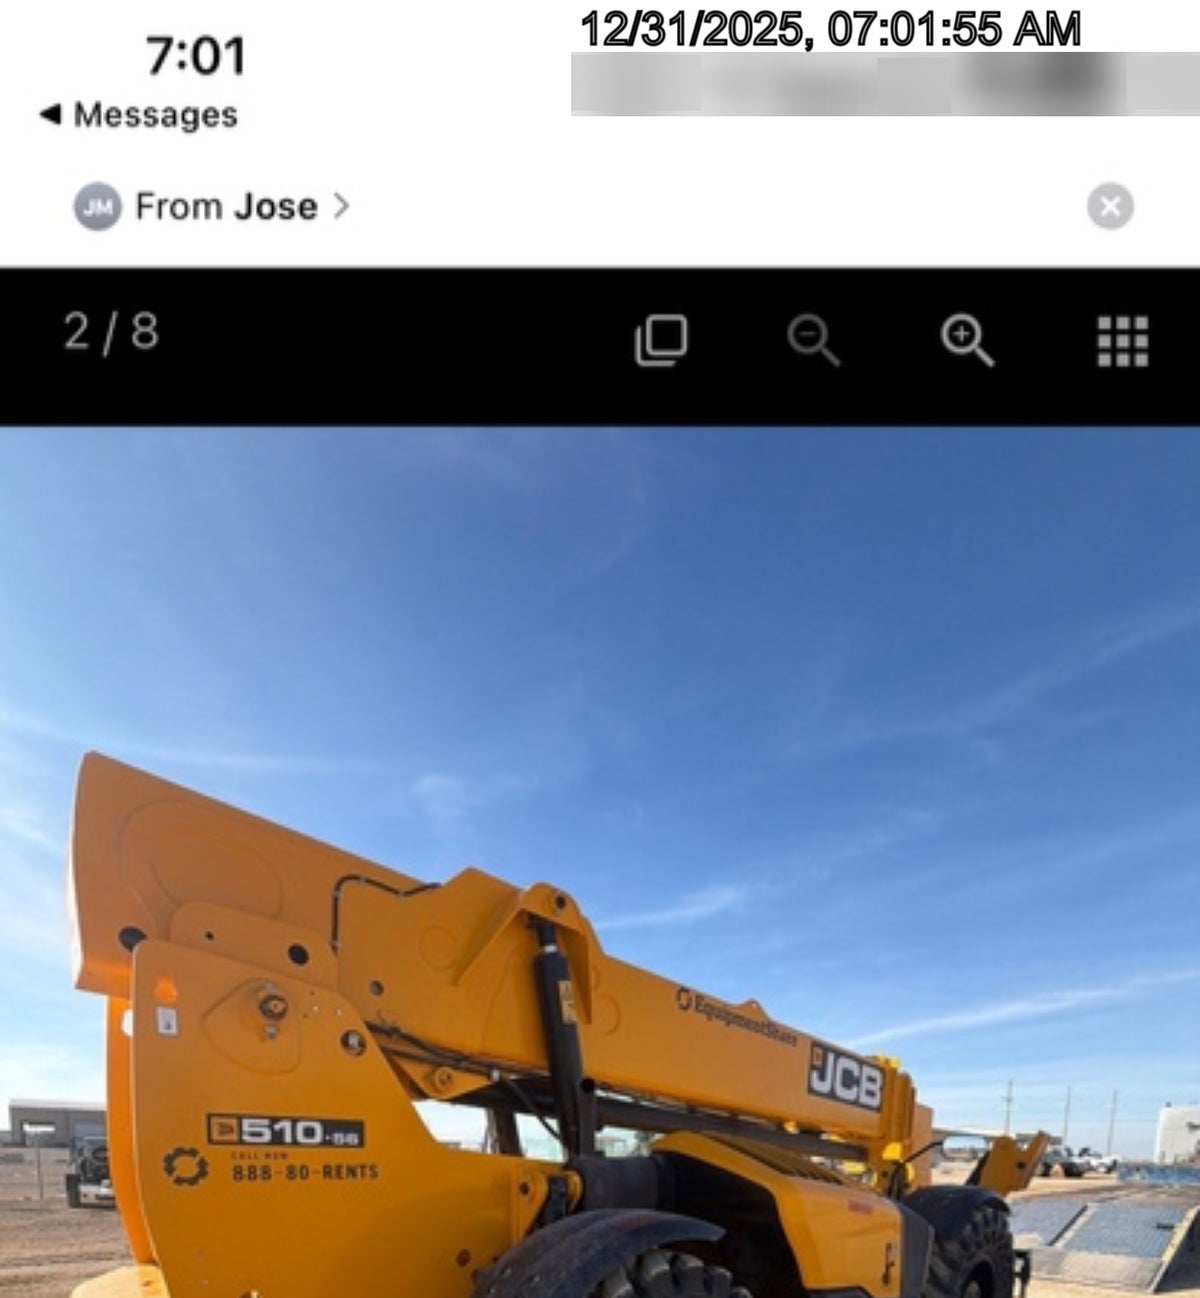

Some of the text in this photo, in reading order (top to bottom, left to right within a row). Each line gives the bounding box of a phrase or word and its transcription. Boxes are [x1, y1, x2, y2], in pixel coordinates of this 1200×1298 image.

[145, 34, 244, 76] 7:01
[74, 100, 238, 133] Messages
[83, 198, 114, 216] JM
[136, 191, 319, 221] From Jose
[64, 310, 89, 349] 2
[131, 310, 158, 349] 8
[809, 1050, 884, 1110] JCB
[232, 1162, 379, 1182] 888-80-RENTS
